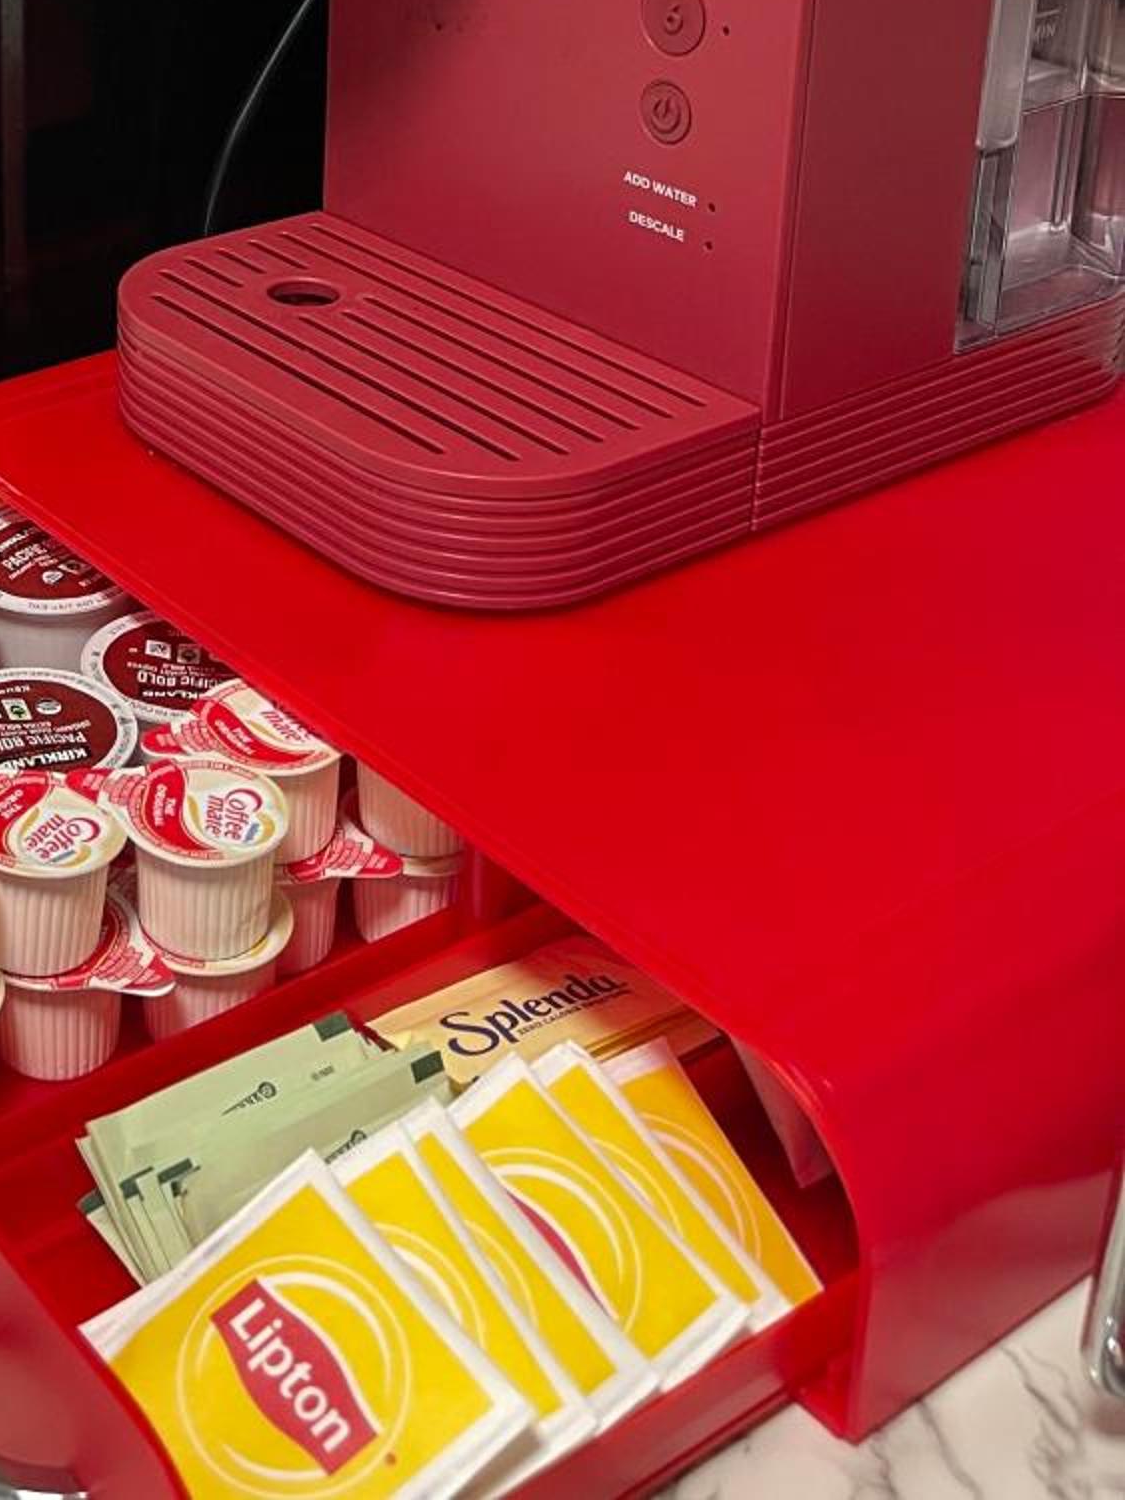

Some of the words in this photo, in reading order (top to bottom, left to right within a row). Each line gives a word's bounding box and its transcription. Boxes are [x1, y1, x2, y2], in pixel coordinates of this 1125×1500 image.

[623, 171, 651, 189] ADD
[652, 181, 698, 208] WATER
[628, 211, 686, 243] DESCALE
[136, 671, 176, 688] BOLD
[142, 688, 202, 700] KLAND
[25, 730, 87, 747] PACIFIC
[25, 814, 67, 851] mate
[204, 794, 224, 837] mate
[224, 787, 263, 842] Coffee
[36, 816, 101, 859] Coffee
[439, 973, 629, 1057] Splenda
[228, 1297, 352, 1453] Lipton
